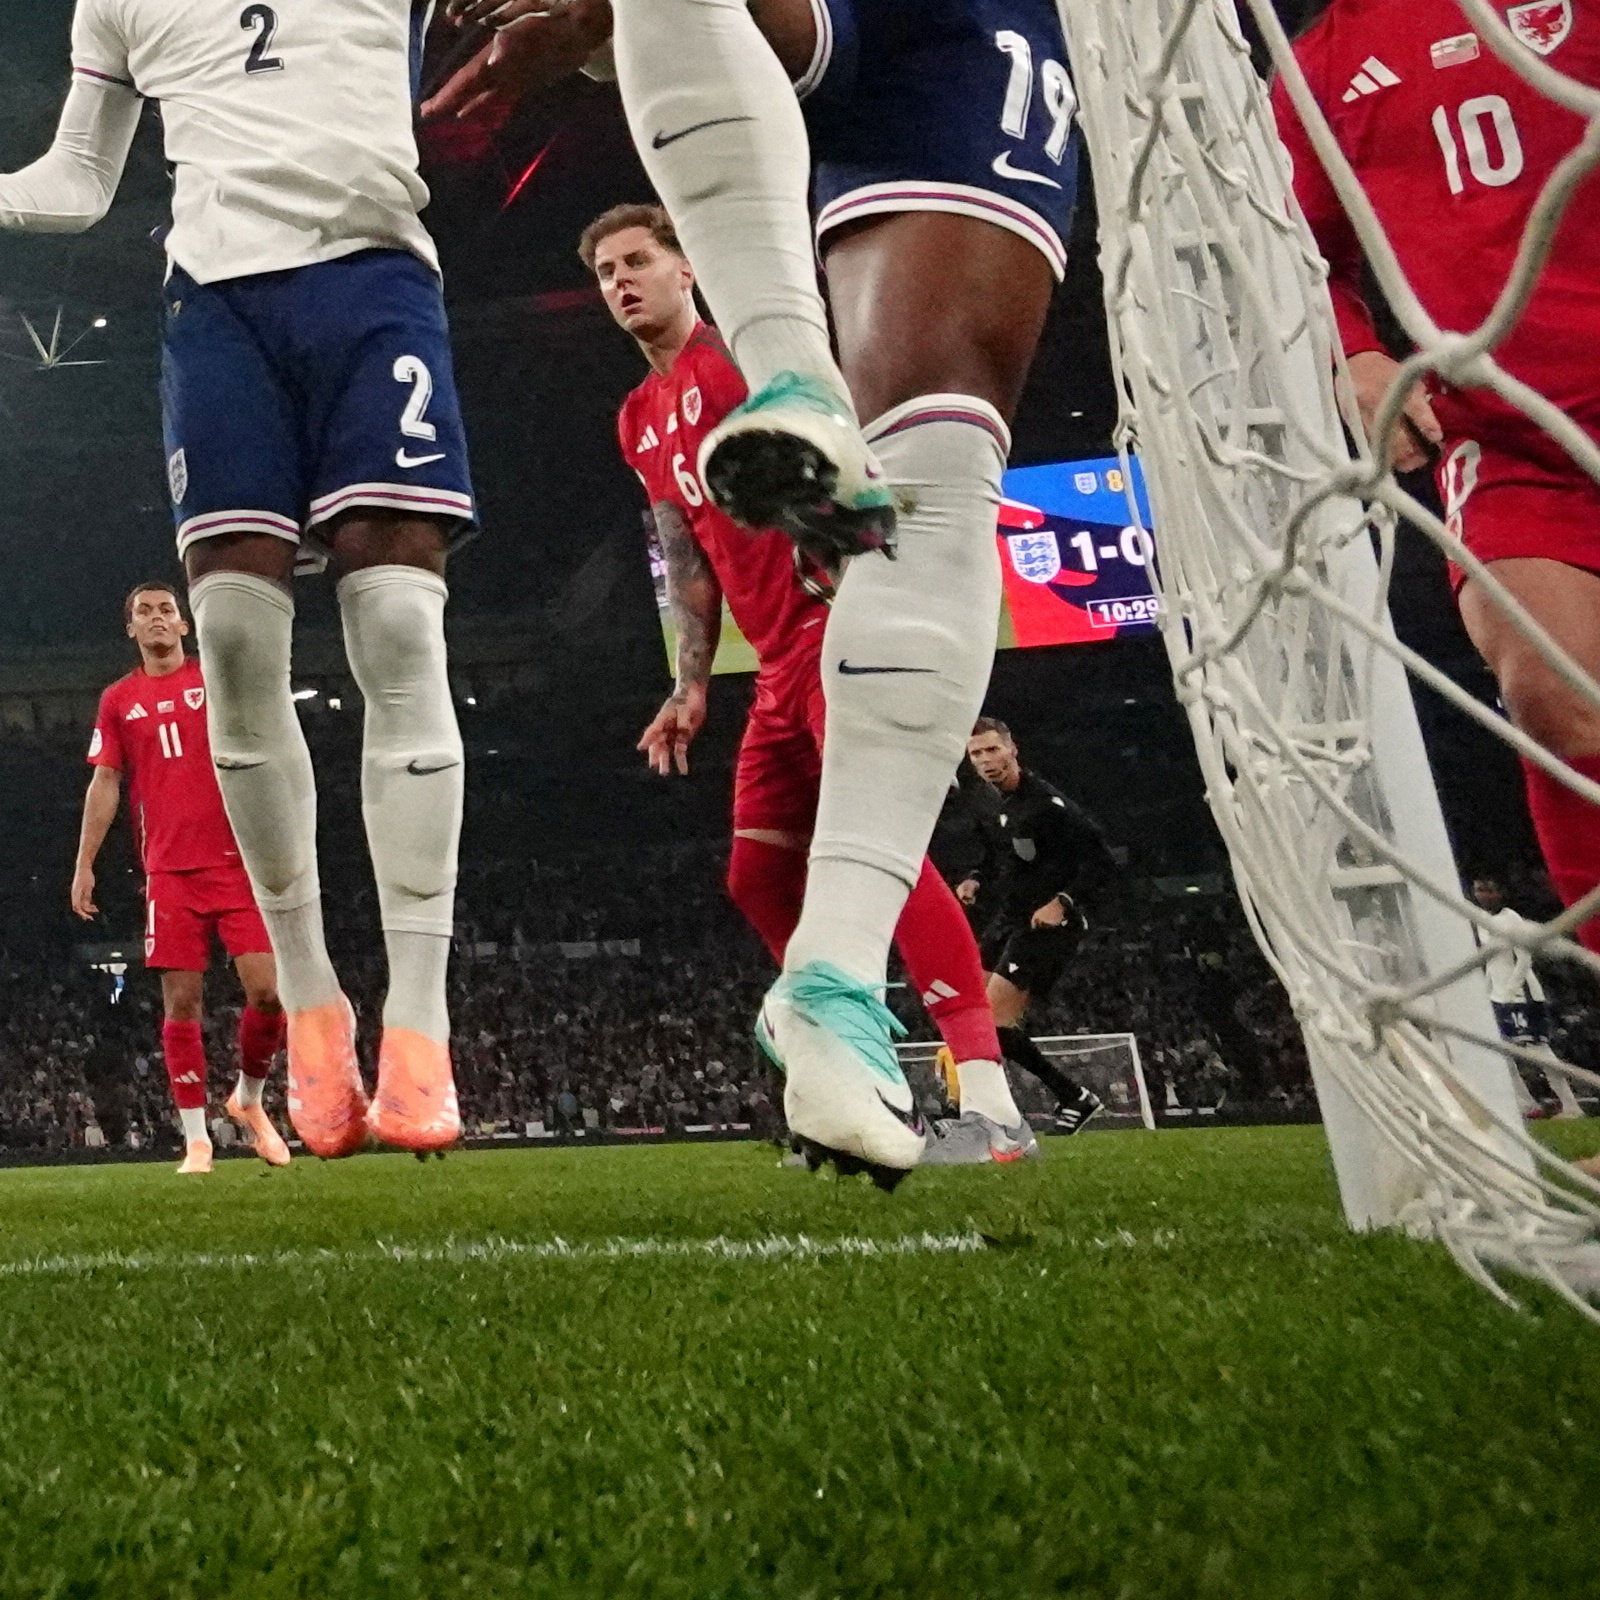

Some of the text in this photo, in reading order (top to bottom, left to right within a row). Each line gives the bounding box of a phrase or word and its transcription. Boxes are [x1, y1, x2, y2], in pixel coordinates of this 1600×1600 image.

[240, 3, 285, 75] 2
[995, 30, 1078, 166] 19
[1431, 94, 1524, 195] 10
[393, 354, 437, 442] 2
[672, 452, 704, 507] 6
[1070, 526, 1154, 571] 1-0
[1098, 600, 1159, 623] 10:29
[159, 721, 183, 758] 11
